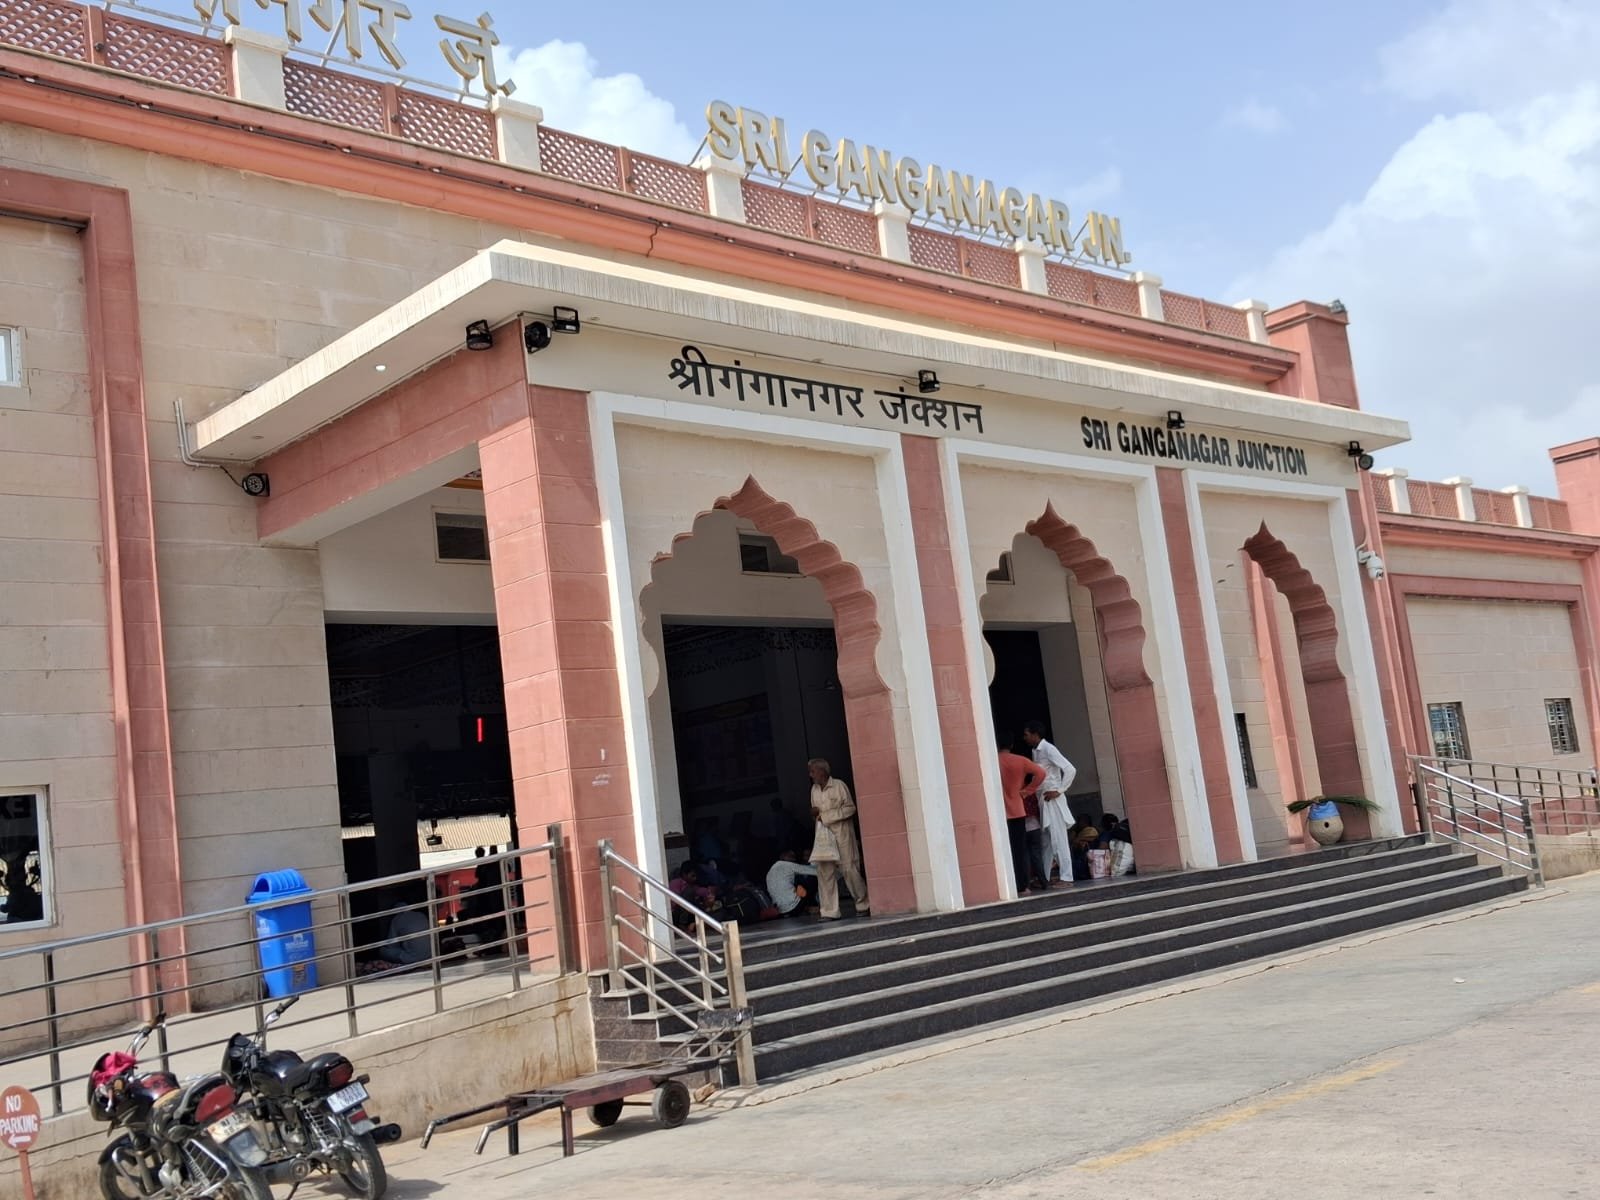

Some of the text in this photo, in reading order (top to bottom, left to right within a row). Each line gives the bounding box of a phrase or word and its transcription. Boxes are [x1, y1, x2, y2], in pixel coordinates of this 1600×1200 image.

[705, 100, 1131, 268] SRI GANGANAGAR JN.
[668, 345, 984, 434] श्रीगंगानगर जंक्शन
[1080, 416, 1308, 475] SRI GANGANAGAR JUNCTION
[0, 1114, 39, 1136] PARKING
[6, 1094, 21, 1113] NO
